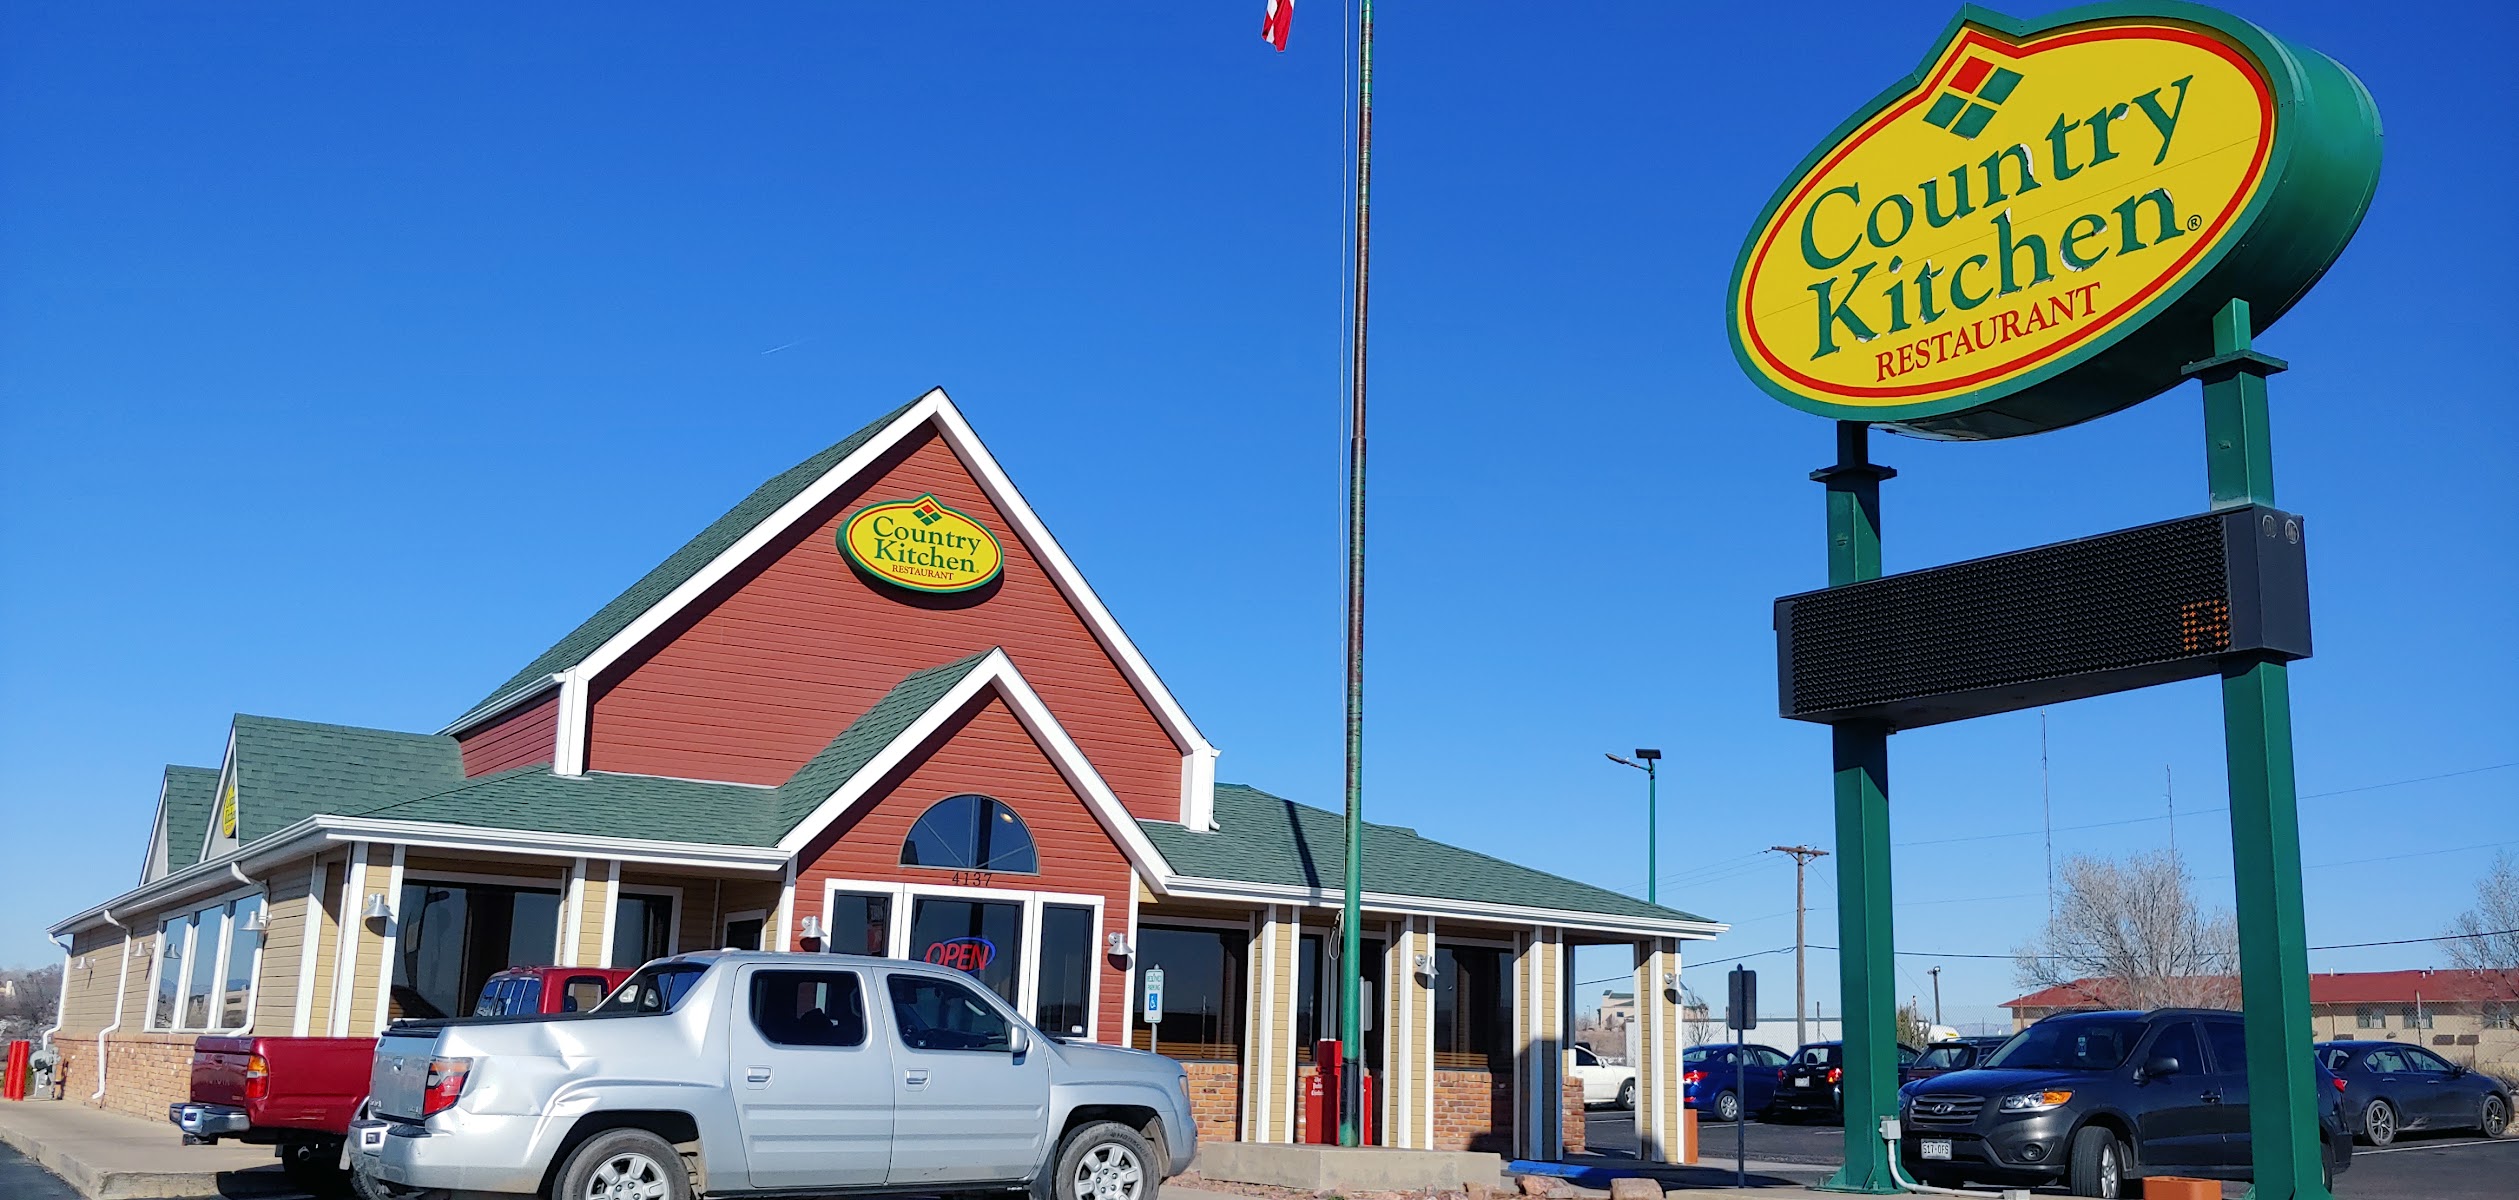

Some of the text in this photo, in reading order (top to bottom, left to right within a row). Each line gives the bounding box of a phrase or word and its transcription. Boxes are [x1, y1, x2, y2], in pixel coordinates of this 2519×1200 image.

[1800, 74, 2194, 271] Country
[1807, 186, 2186, 362] Kitchen
[1874, 281, 2101, 383] RESTAURANT
[873, 515, 981, 556] Country
[874, 537, 976, 574] Kitchen
[892, 564, 954, 580] RESTAURANT
[952, 871, 992, 887] 4137
[925, 942, 990, 971] OPEN
